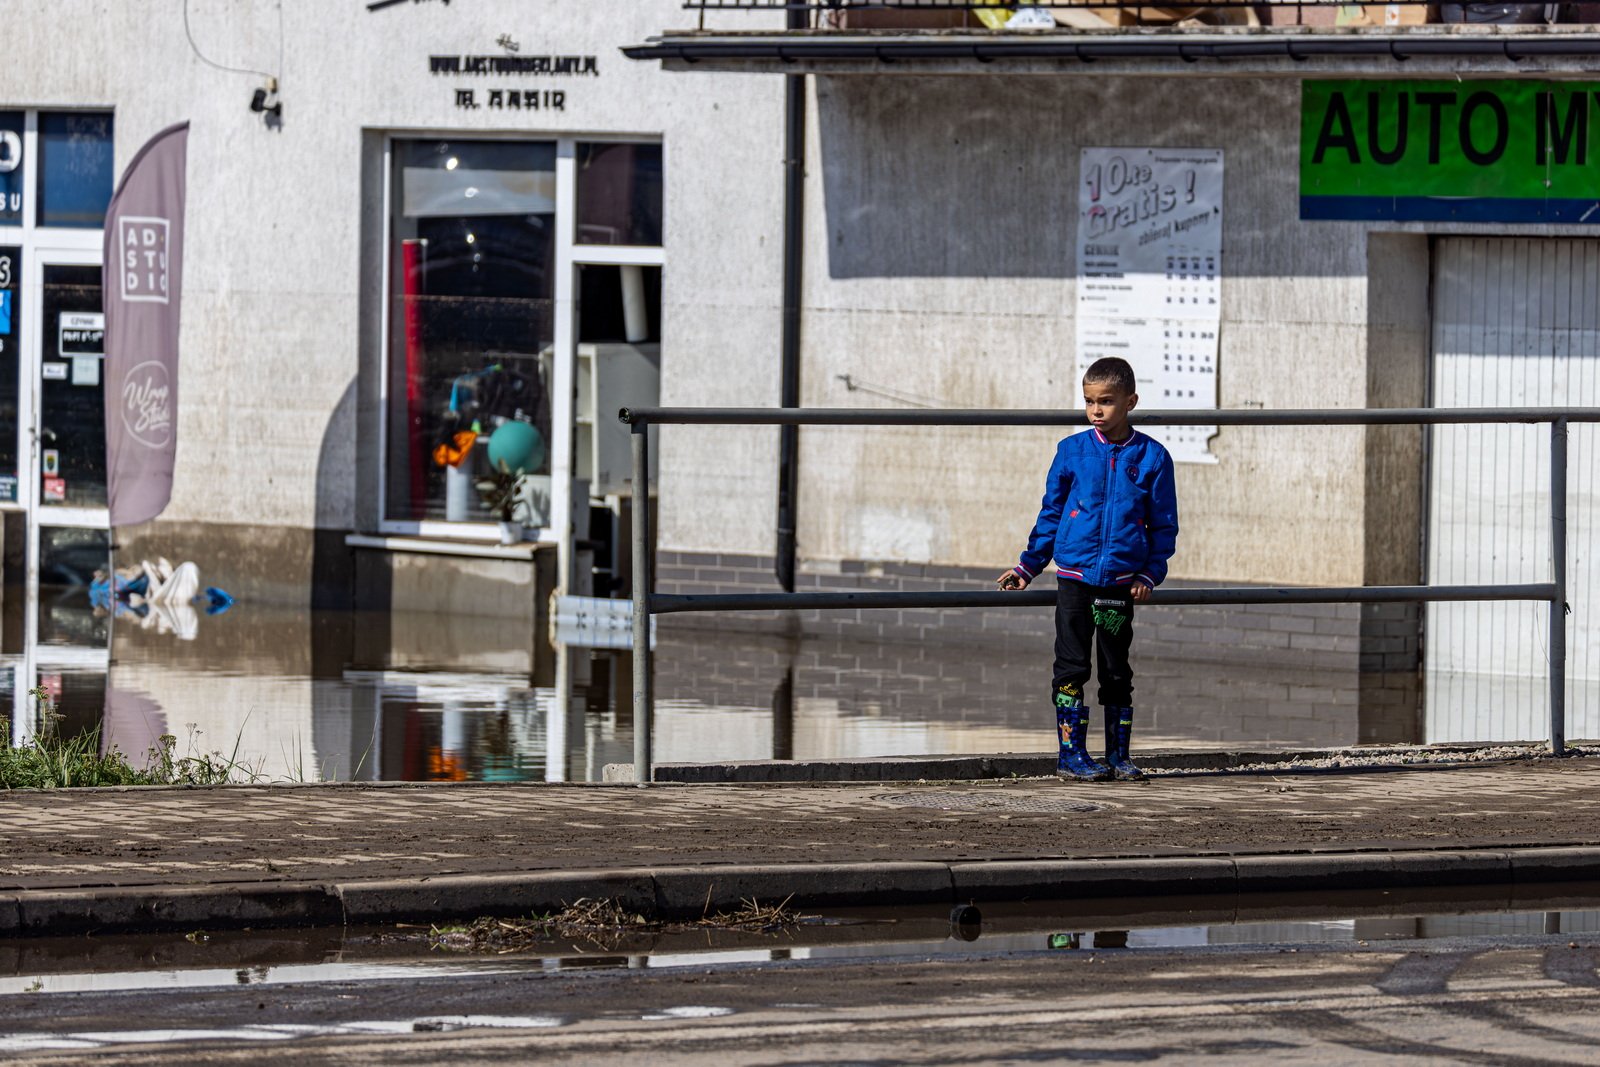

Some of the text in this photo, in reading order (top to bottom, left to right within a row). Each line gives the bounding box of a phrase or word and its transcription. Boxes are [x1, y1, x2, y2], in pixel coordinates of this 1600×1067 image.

[1311, 91, 1600, 166] AUTO M
[126, 228, 157, 247] AD
